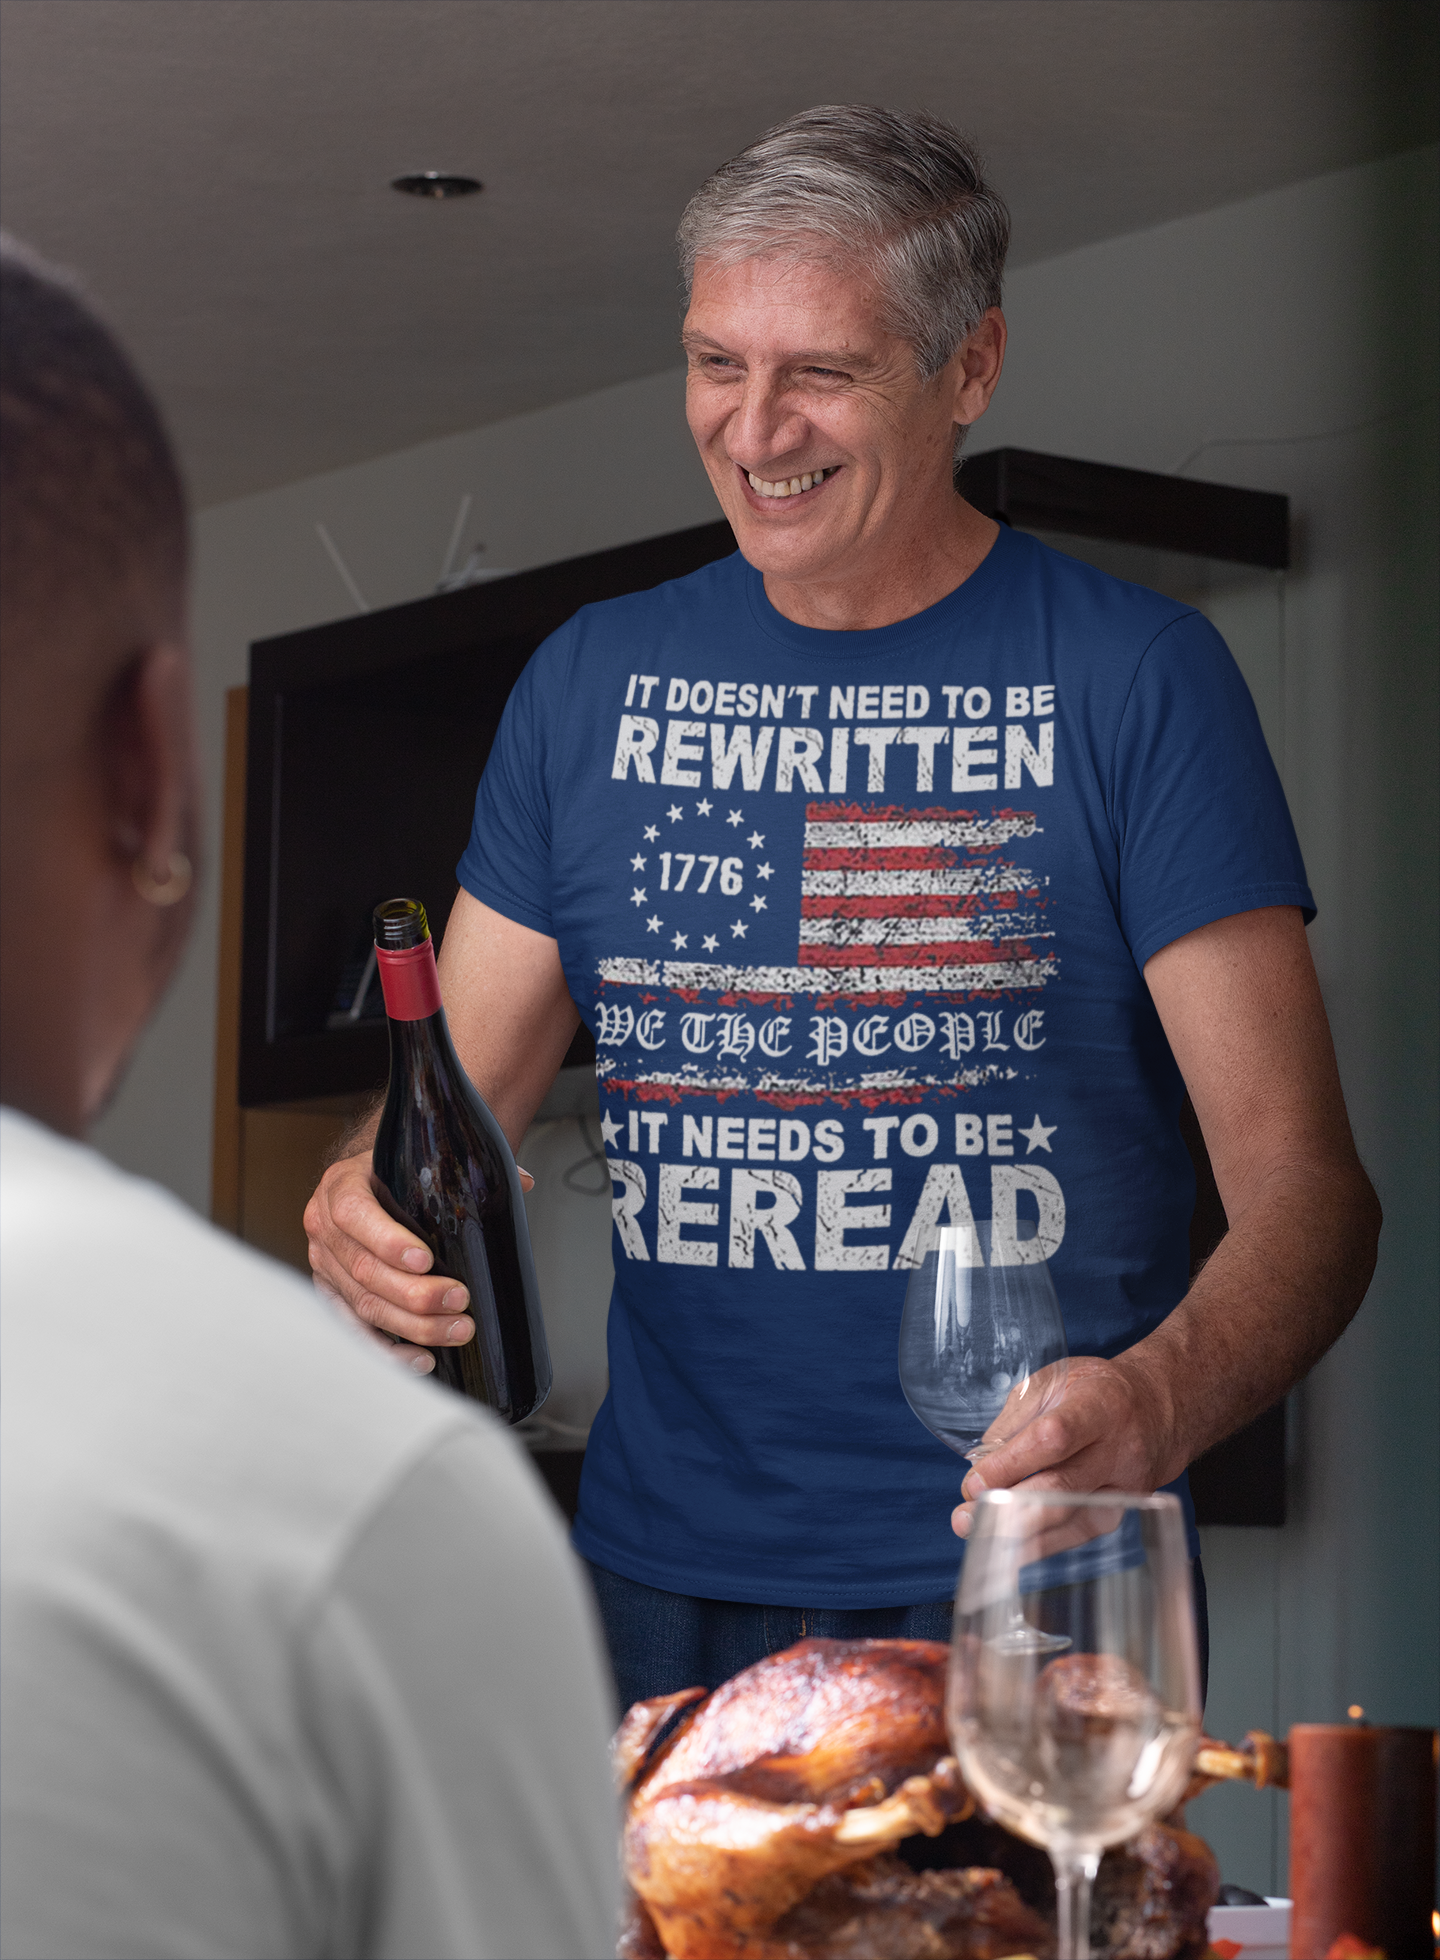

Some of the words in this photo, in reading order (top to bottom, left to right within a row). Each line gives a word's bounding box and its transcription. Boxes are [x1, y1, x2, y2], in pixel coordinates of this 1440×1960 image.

[624, 674, 660, 708] IT
[665, 677, 819, 719] DOESN'T
[828, 685, 930, 719] NEED
[941, 686, 992, 718] TO
[1005, 685, 1056, 717] BE
[611, 713, 1055, 793] REWRITTEN
[659, 852, 744, 895] 1776
[595, 1002, 667, 1051] WE
[680, 1012, 793, 1063] THE
[806, 1009, 1047, 1066] PEOPLE
[628, 1110, 668, 1154] IT
[682, 1115, 845, 1163] NEEDS
[863, 1114, 939, 1160] TO
[955, 1114, 1015, 1156] BE
[606, 1158, 1066, 1271] REREAD
